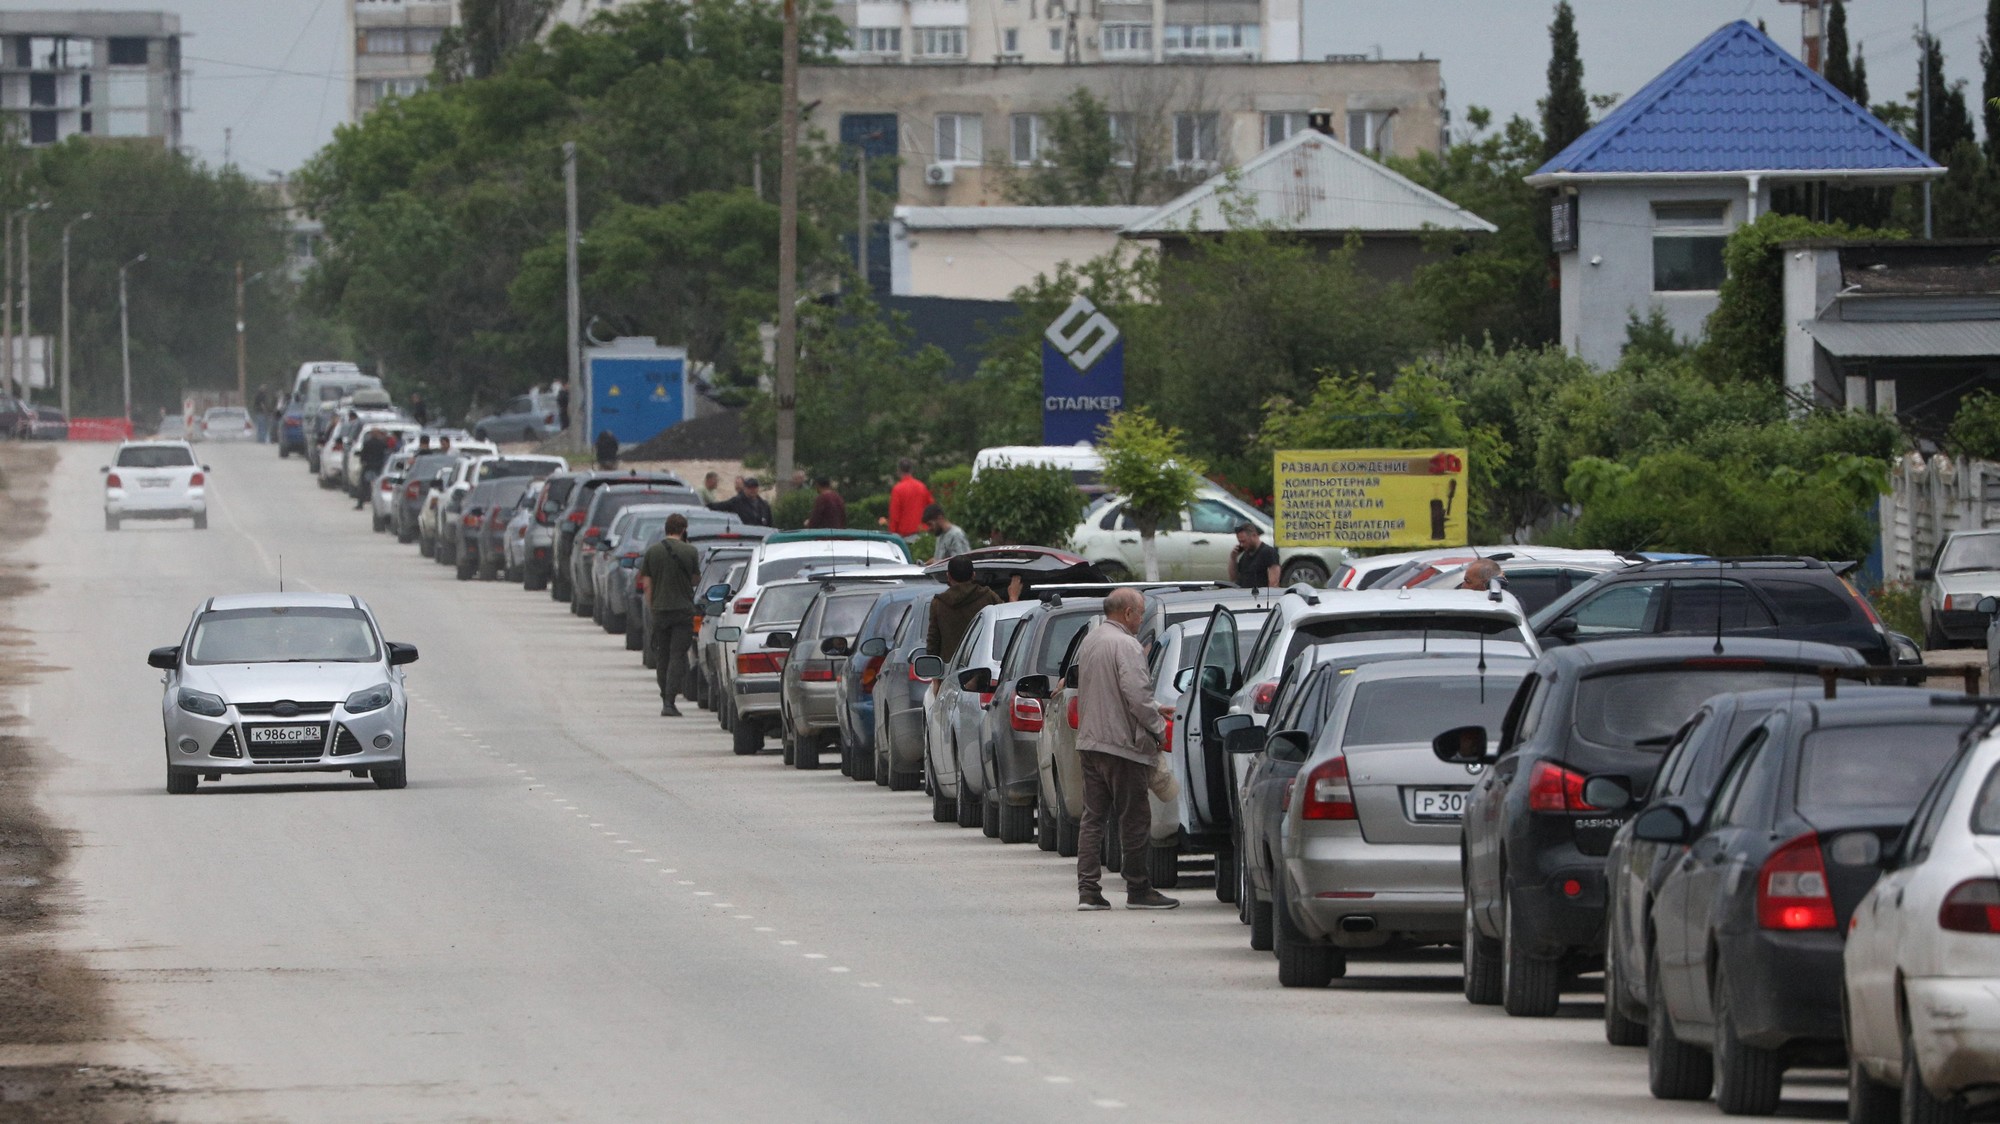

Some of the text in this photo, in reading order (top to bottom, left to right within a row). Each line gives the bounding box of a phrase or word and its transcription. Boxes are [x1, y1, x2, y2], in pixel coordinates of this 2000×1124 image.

[1045, 396, 1122, 410] СТАЛКЕР
[1281, 462, 1329, 473] РАЗВАЛ
[1331, 461, 1409, 473] СХОЖДЕНИЕ
[1282, 488, 1365, 499] ДИАГНОСТИКА
[1334, 499, 1373, 509] МАСЕЛ
[1375, 499, 1384, 508] И
[1282, 509, 1352, 520] ЖИДКОСТЕЙ
[1334, 519, 1405, 530] ДВИГАТЕЛЕЙ
[1335, 530, 1390, 541] ХОДОВОЙ
[1424, 794, 1468, 811] Р30
